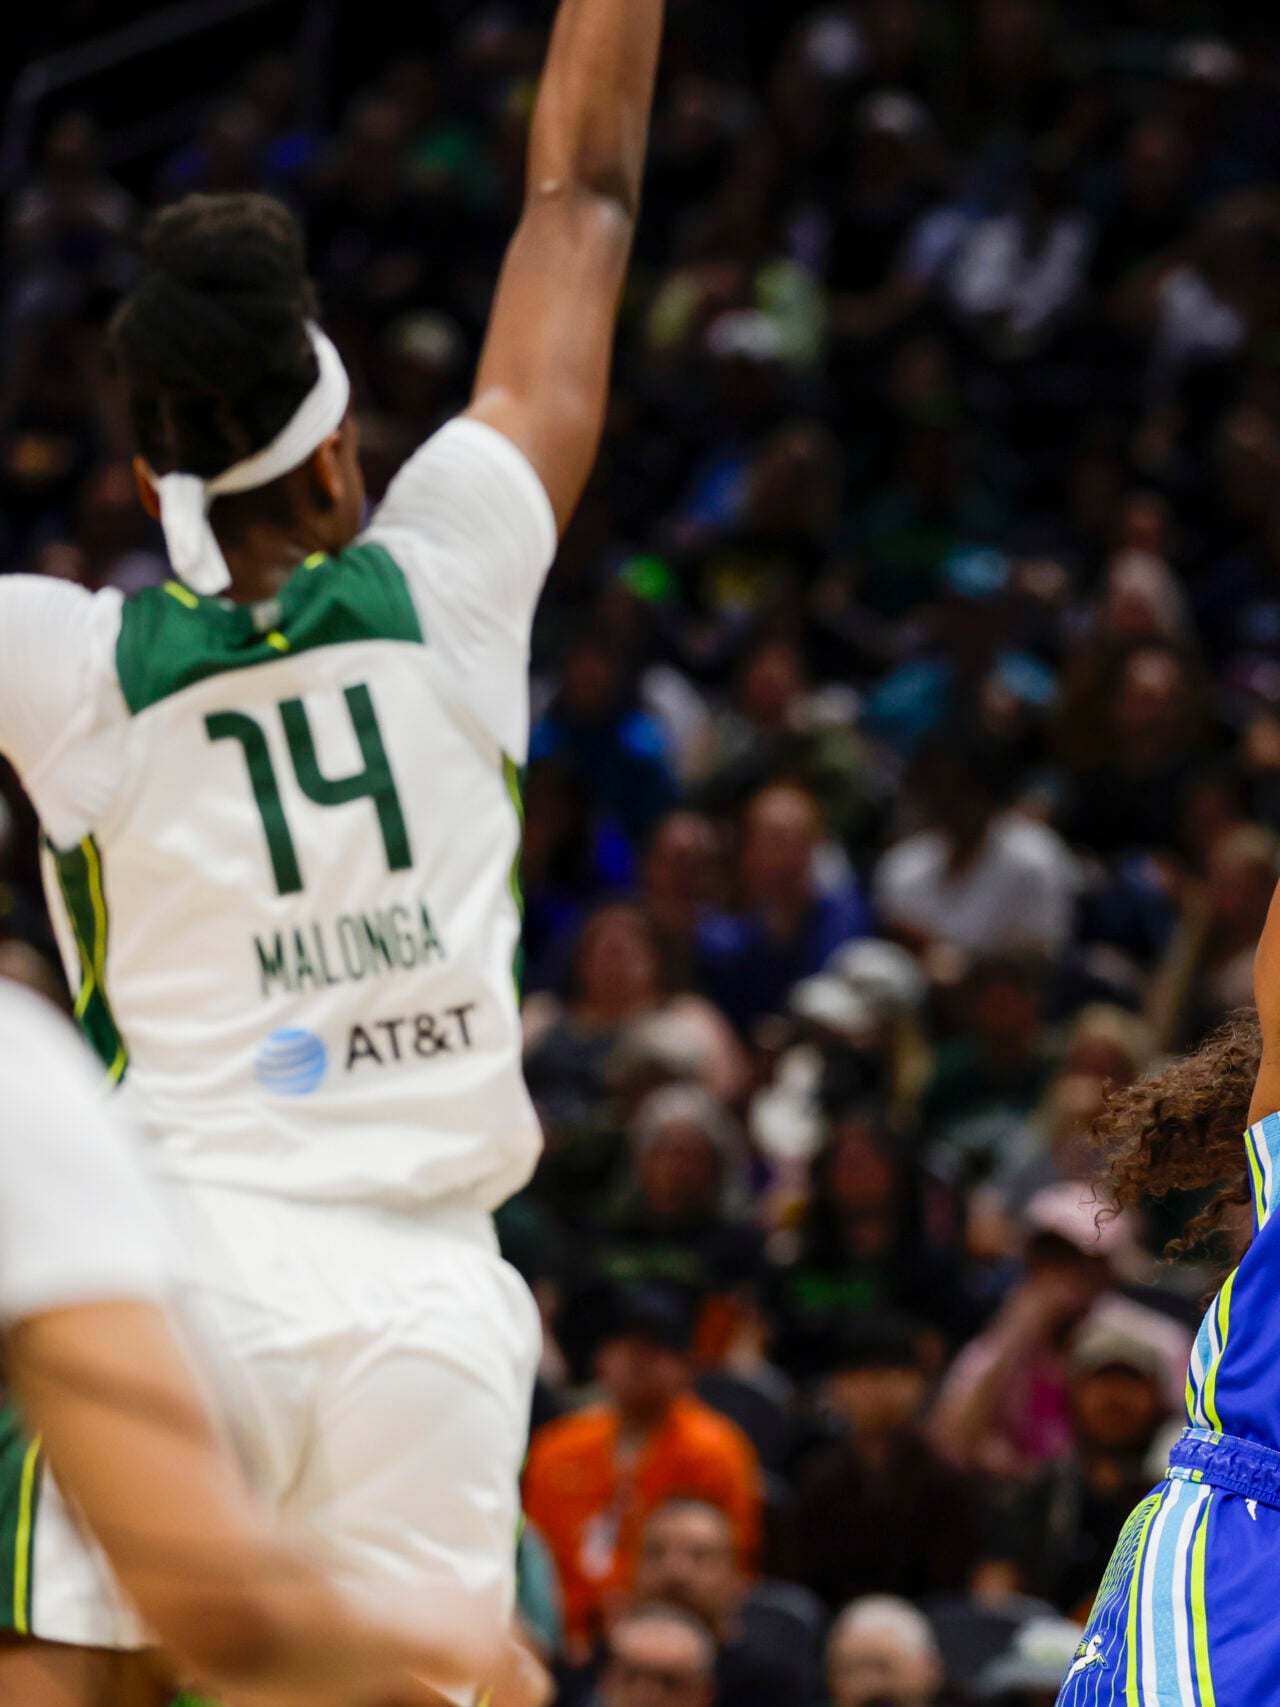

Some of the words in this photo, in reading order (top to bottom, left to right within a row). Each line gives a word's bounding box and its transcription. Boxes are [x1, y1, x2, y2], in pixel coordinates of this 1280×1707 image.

[204, 683, 413, 896] 14
[253, 900, 445, 997] MALONGA
[345, 1004, 476, 1071] AT&T
